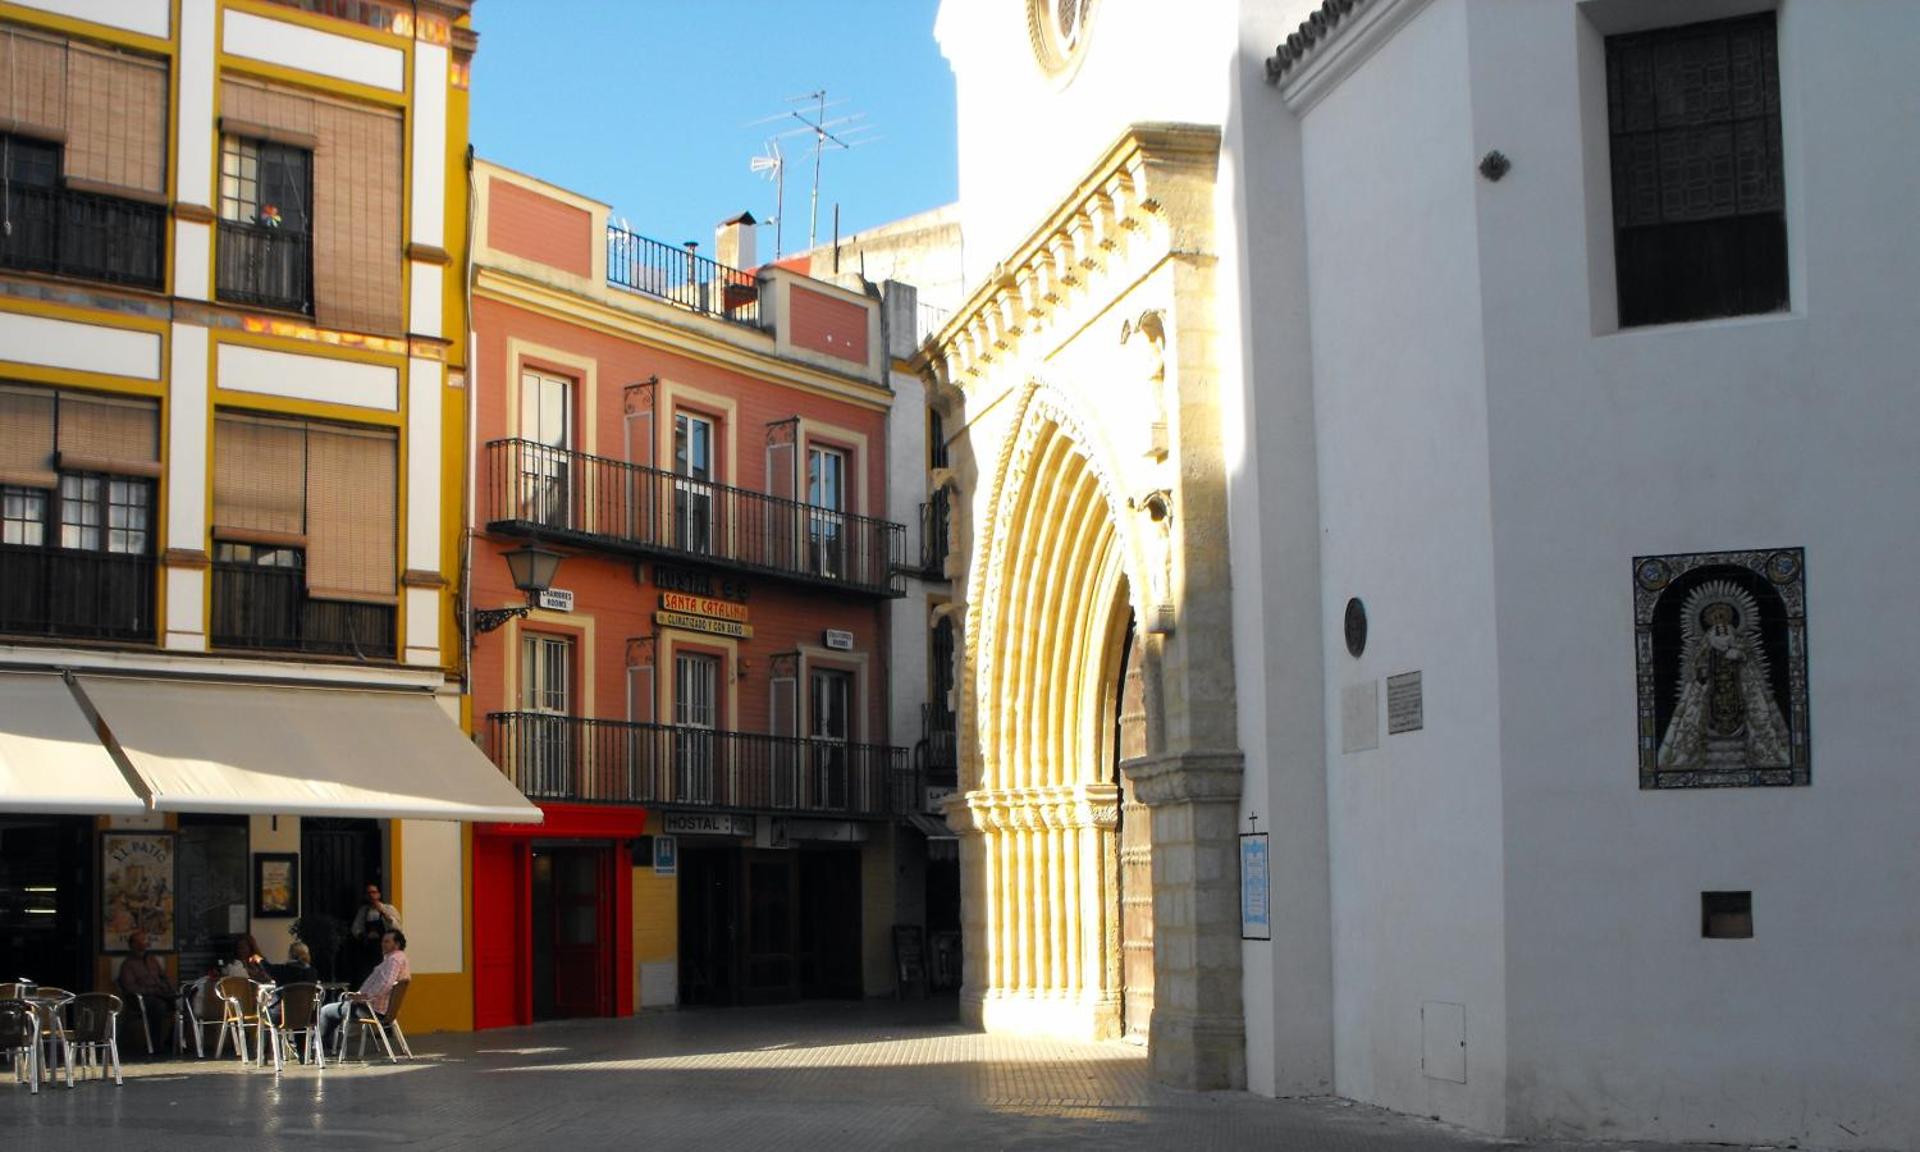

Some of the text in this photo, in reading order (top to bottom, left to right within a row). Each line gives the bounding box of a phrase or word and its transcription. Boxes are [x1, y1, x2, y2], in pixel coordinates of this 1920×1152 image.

[665, 593, 746, 620] SANTA CATALINA
[713, 621, 726, 633] CON
[667, 815, 720, 830] HOSTAL
[112, 841, 166, 864] EL PATIO
